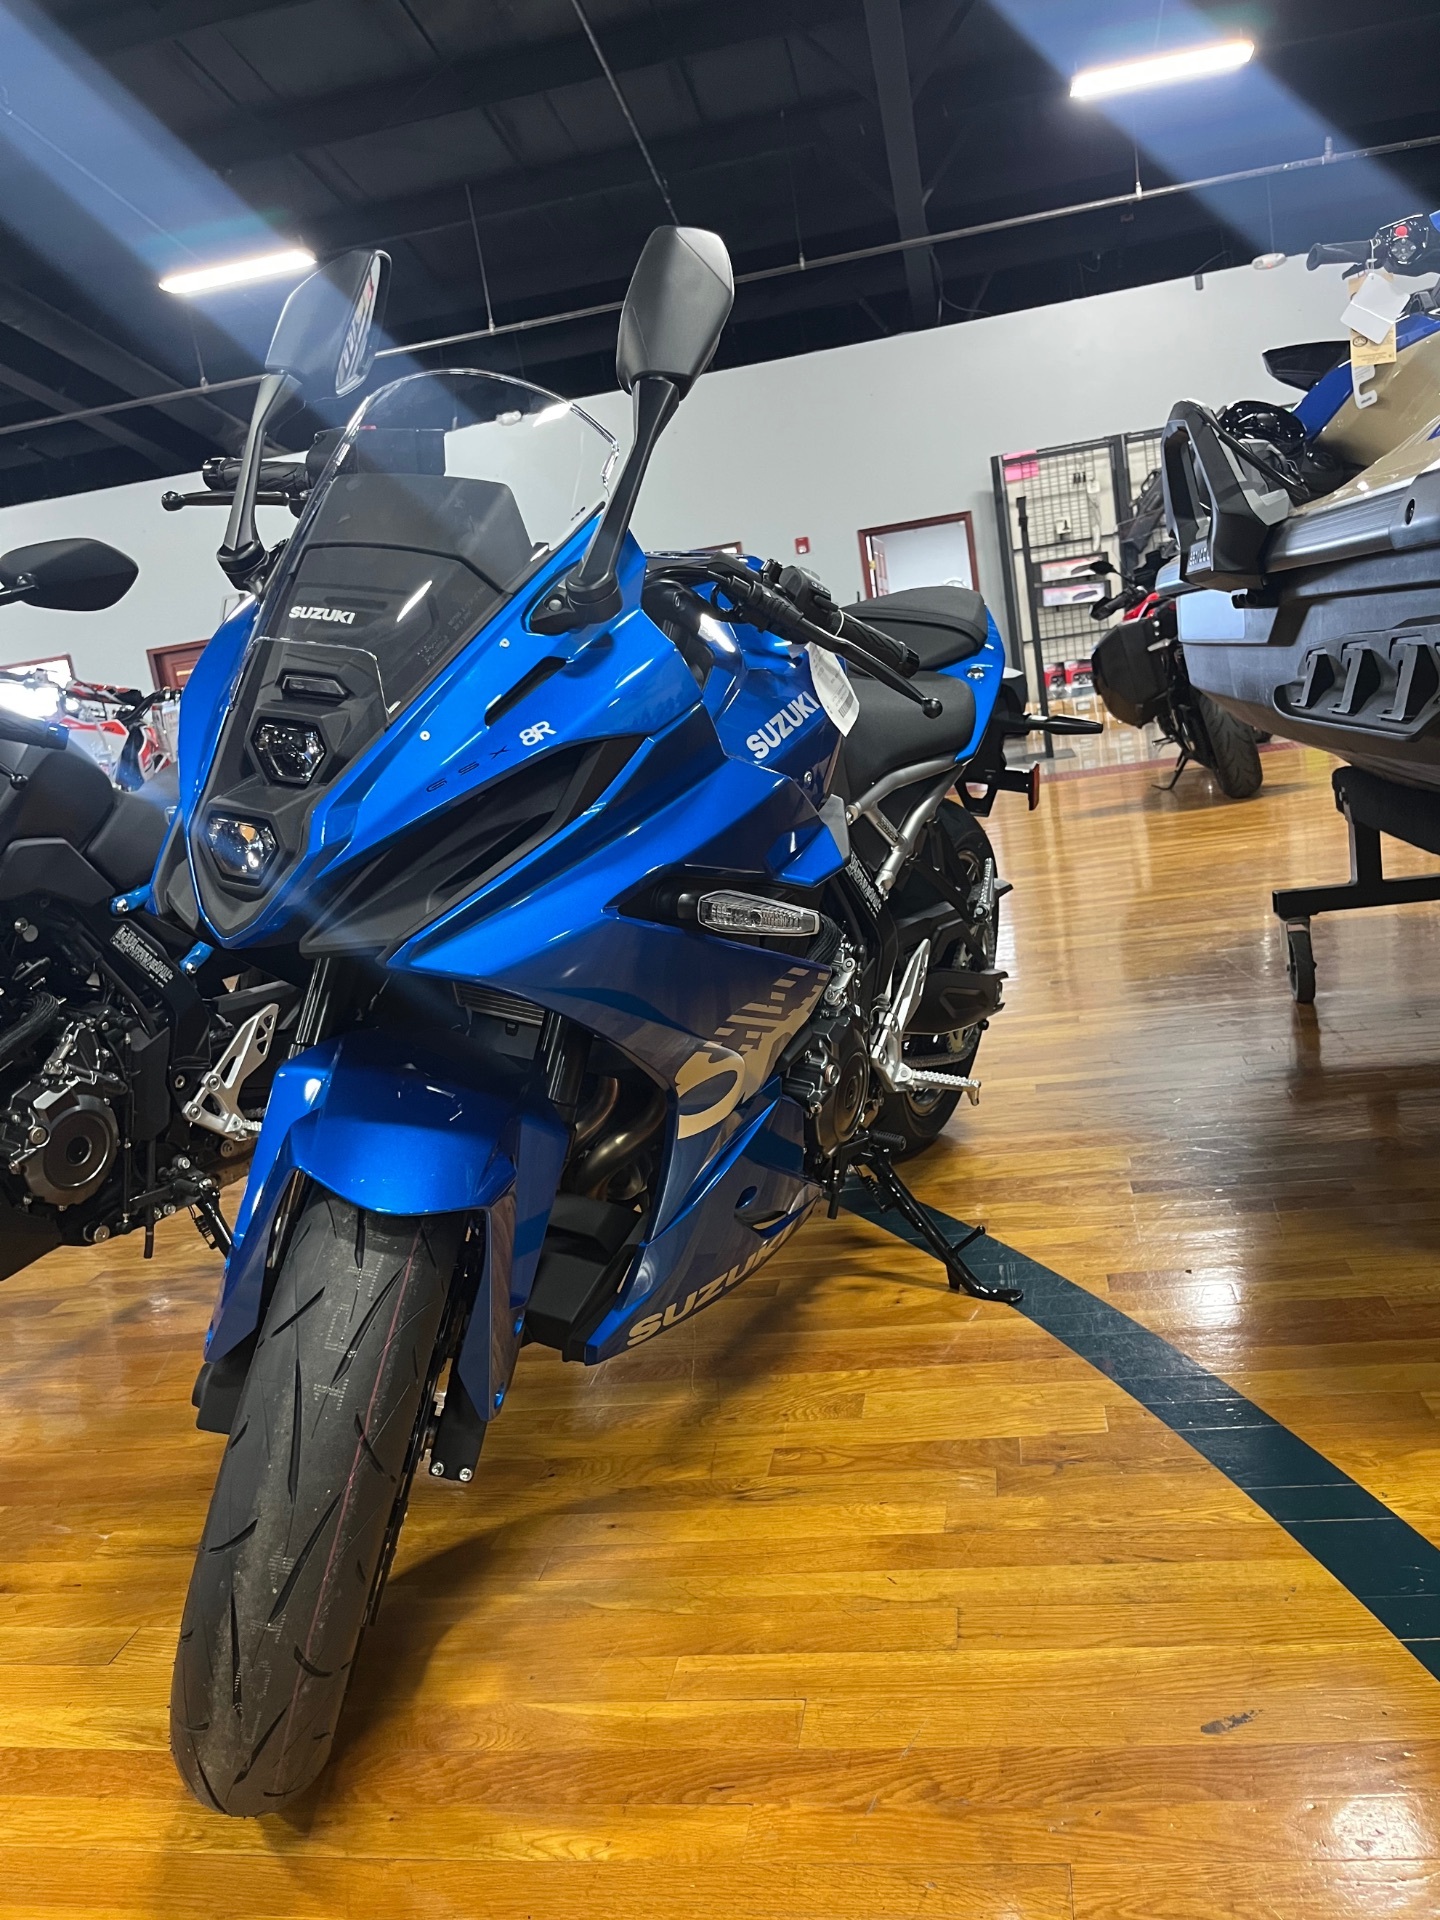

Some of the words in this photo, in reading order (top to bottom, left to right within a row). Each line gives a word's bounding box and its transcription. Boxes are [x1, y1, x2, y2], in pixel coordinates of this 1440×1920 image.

[289, 606, 355, 625] SUZUKI
[519, 721, 557, 746] 8R
[746, 691, 821, 759] SUZUKI
